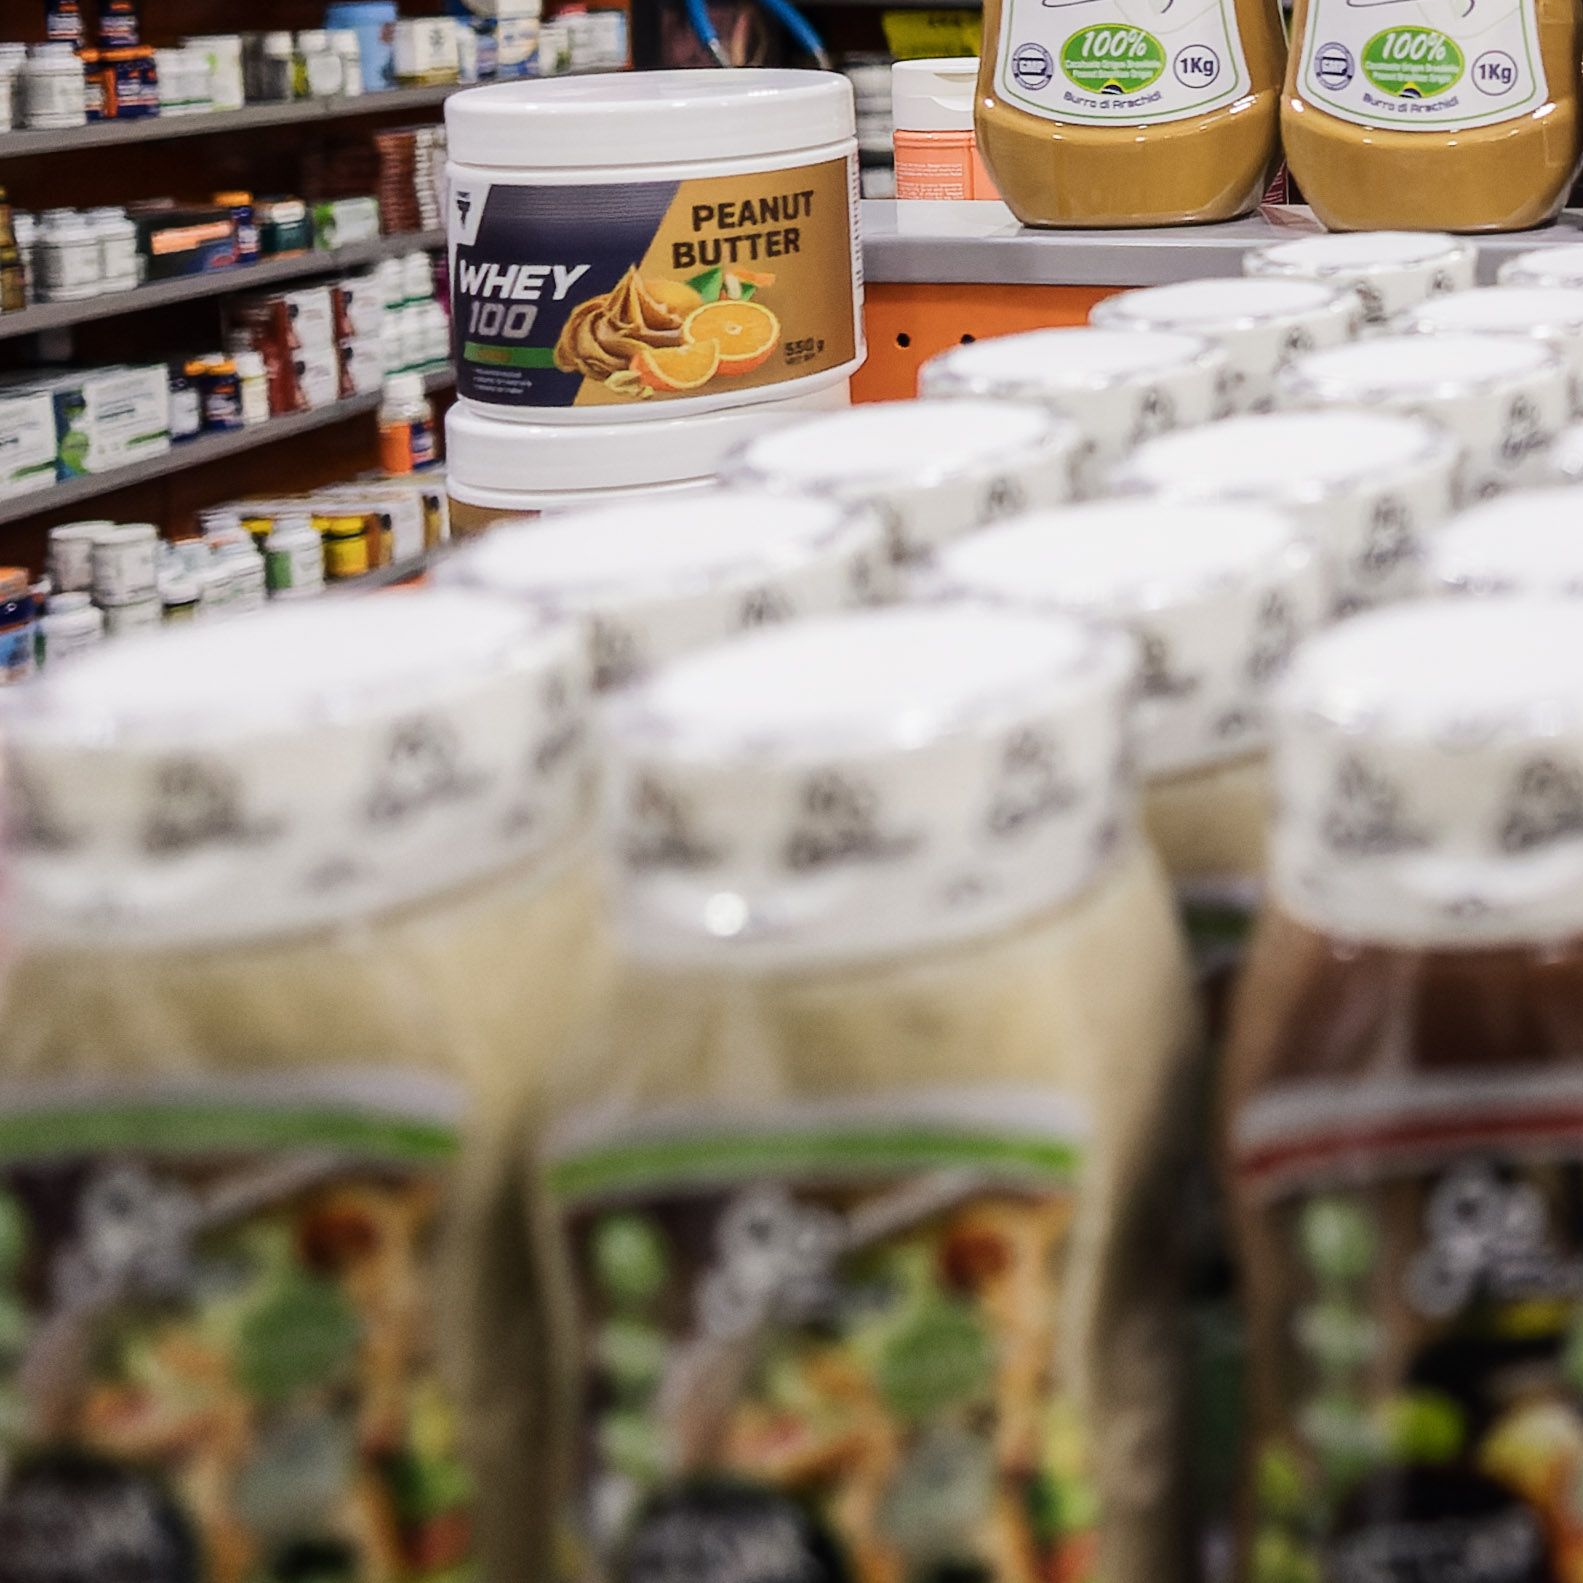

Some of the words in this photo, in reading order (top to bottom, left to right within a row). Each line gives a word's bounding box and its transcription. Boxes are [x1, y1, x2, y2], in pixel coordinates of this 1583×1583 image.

[1081, 30, 1147, 57] 100%
[1382, 32, 1446, 61] 100%
[1180, 57, 1214, 77] 1Kg
[1479, 63, 1512, 84] 1Kg
[692, 190, 814, 232] PEANUT
[672, 227, 800, 269] BUTTER
[460, 260, 591, 300] WHEY
[468, 302, 537, 338] 100
